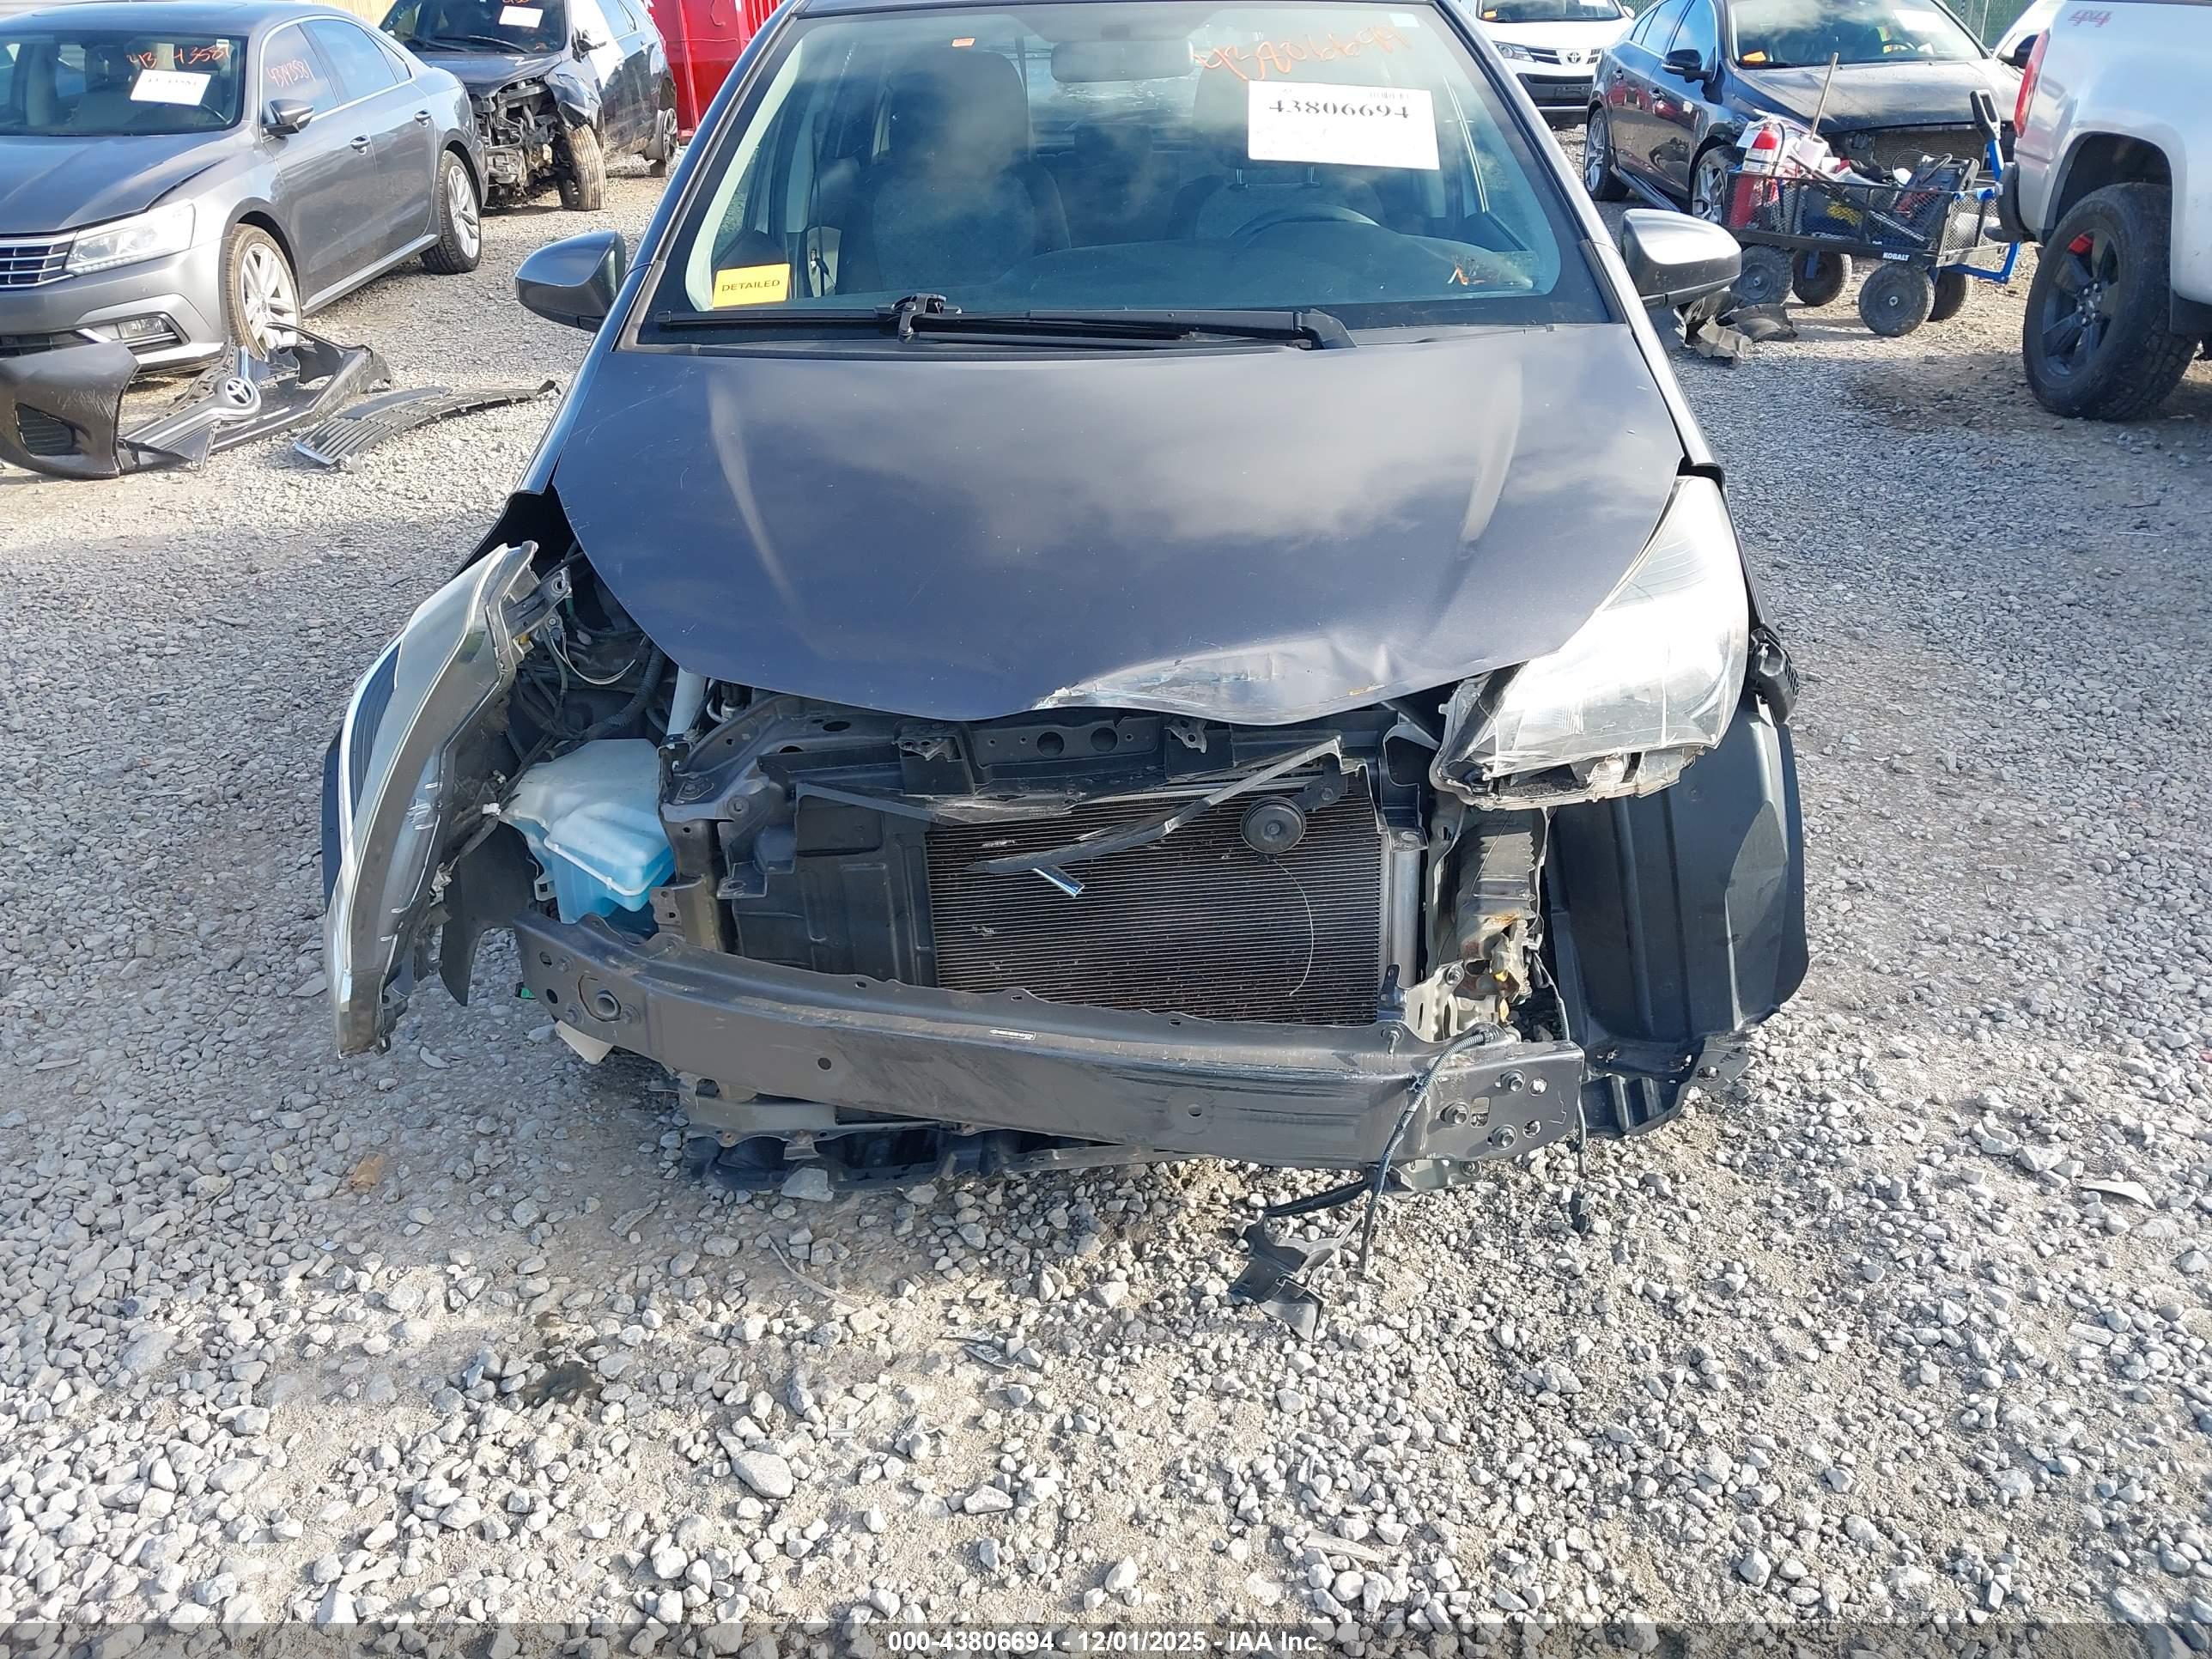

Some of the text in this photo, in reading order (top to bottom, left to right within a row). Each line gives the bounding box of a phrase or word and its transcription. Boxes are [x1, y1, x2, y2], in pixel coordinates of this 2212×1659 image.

[126, 44, 229, 69] 4343581
[1268, 99, 1409, 119] 43806694
[1883, 252, 1911, 261] KOBALT
[721, 279, 781, 292] DETAILED
